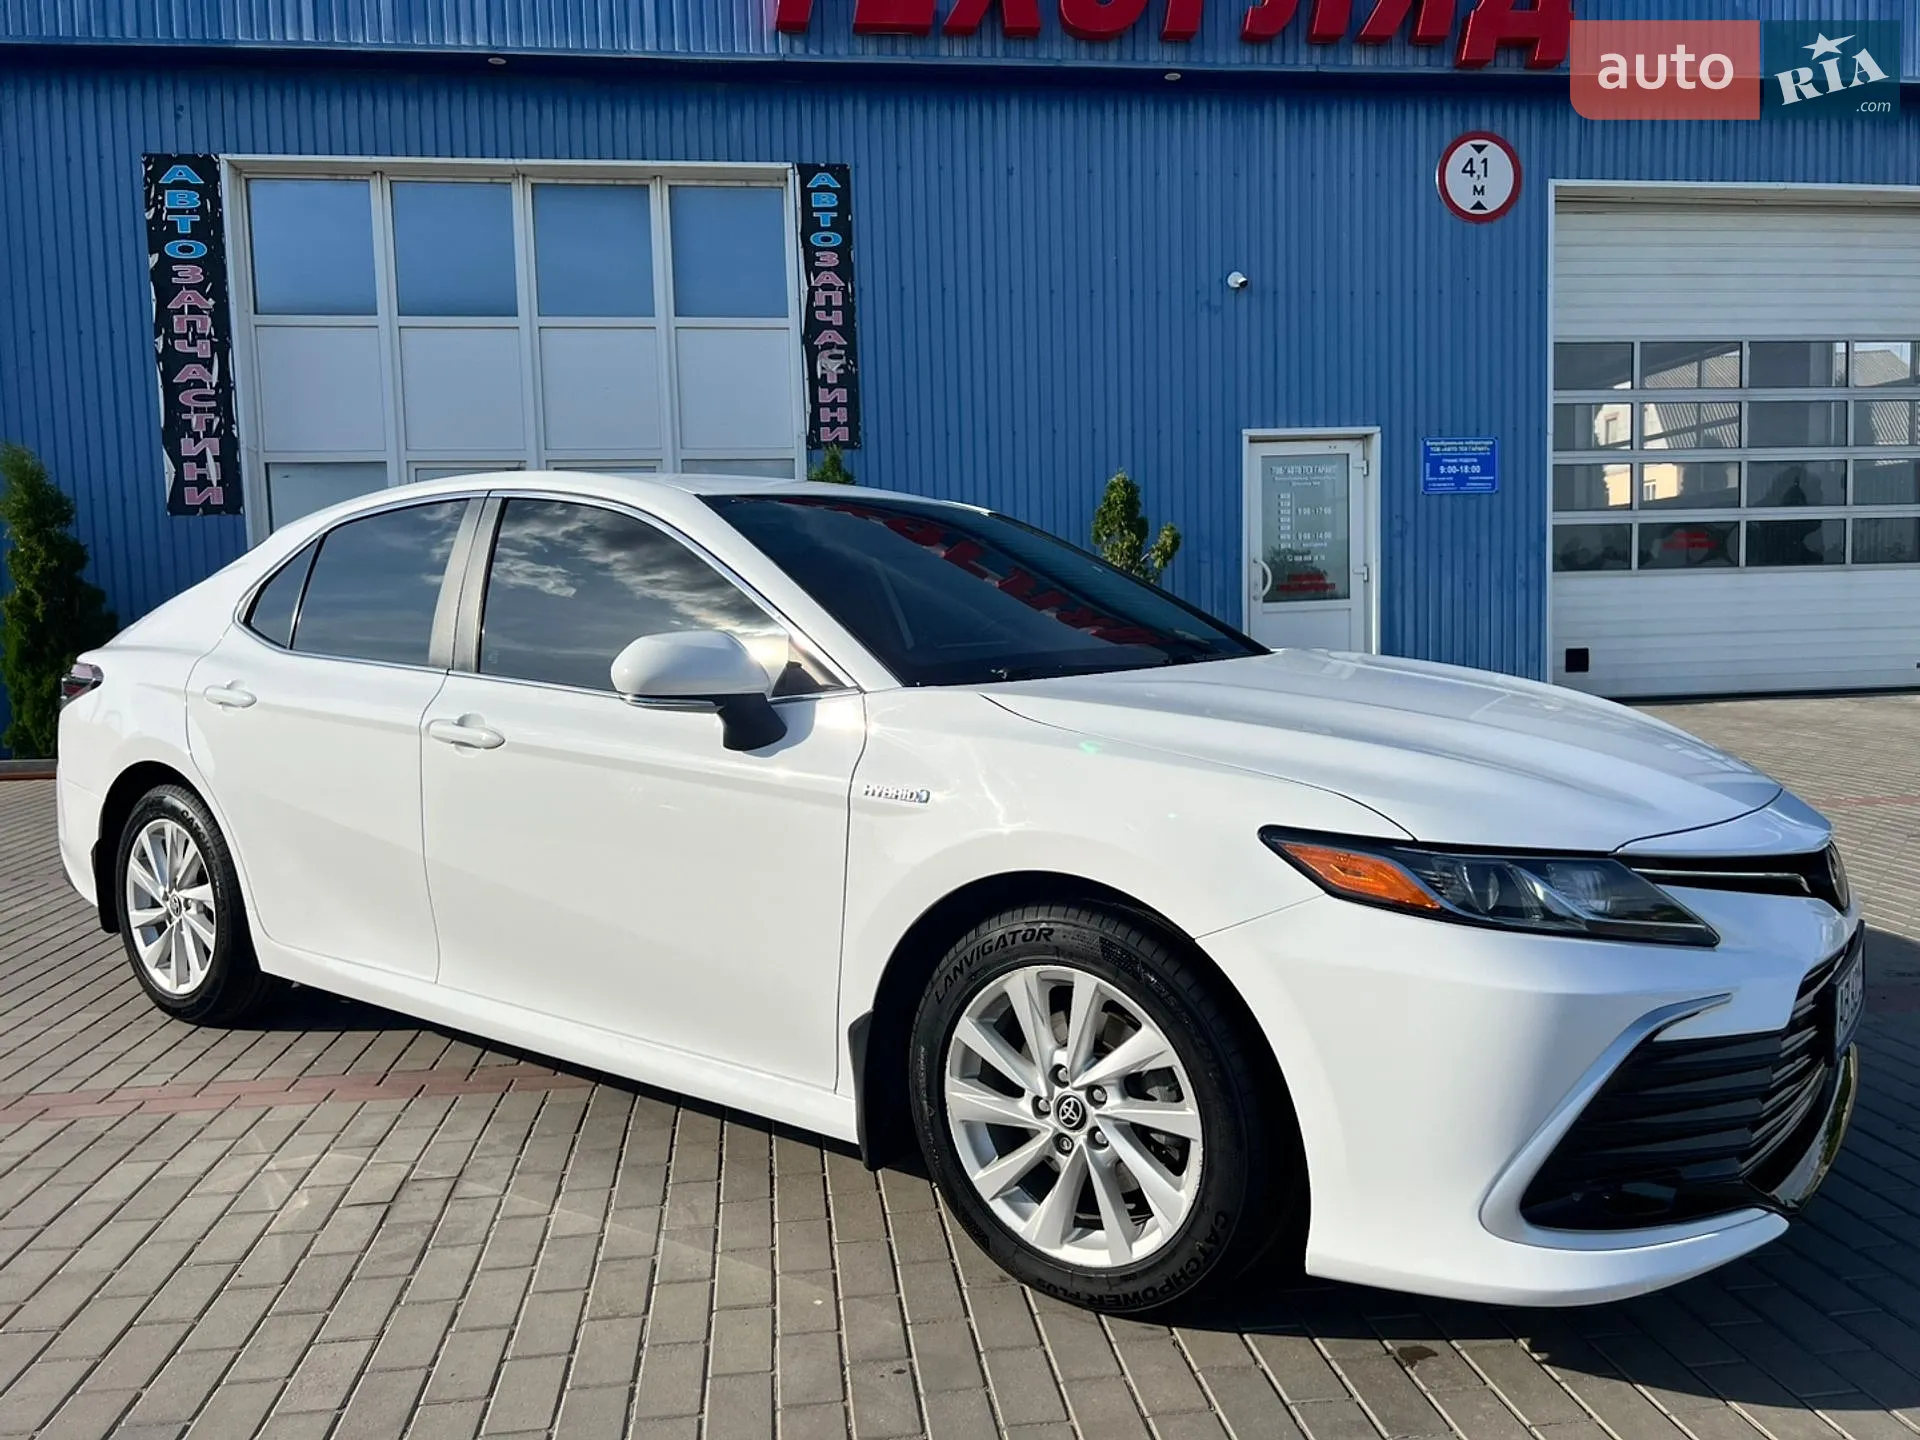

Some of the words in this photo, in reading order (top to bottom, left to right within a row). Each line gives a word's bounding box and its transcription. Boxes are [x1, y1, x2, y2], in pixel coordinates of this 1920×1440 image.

[1461, 157, 1488, 180] 4,1
[863, 784, 918, 803] HYBRID
[934, 927, 1055, 1005] LANVIGATOR
